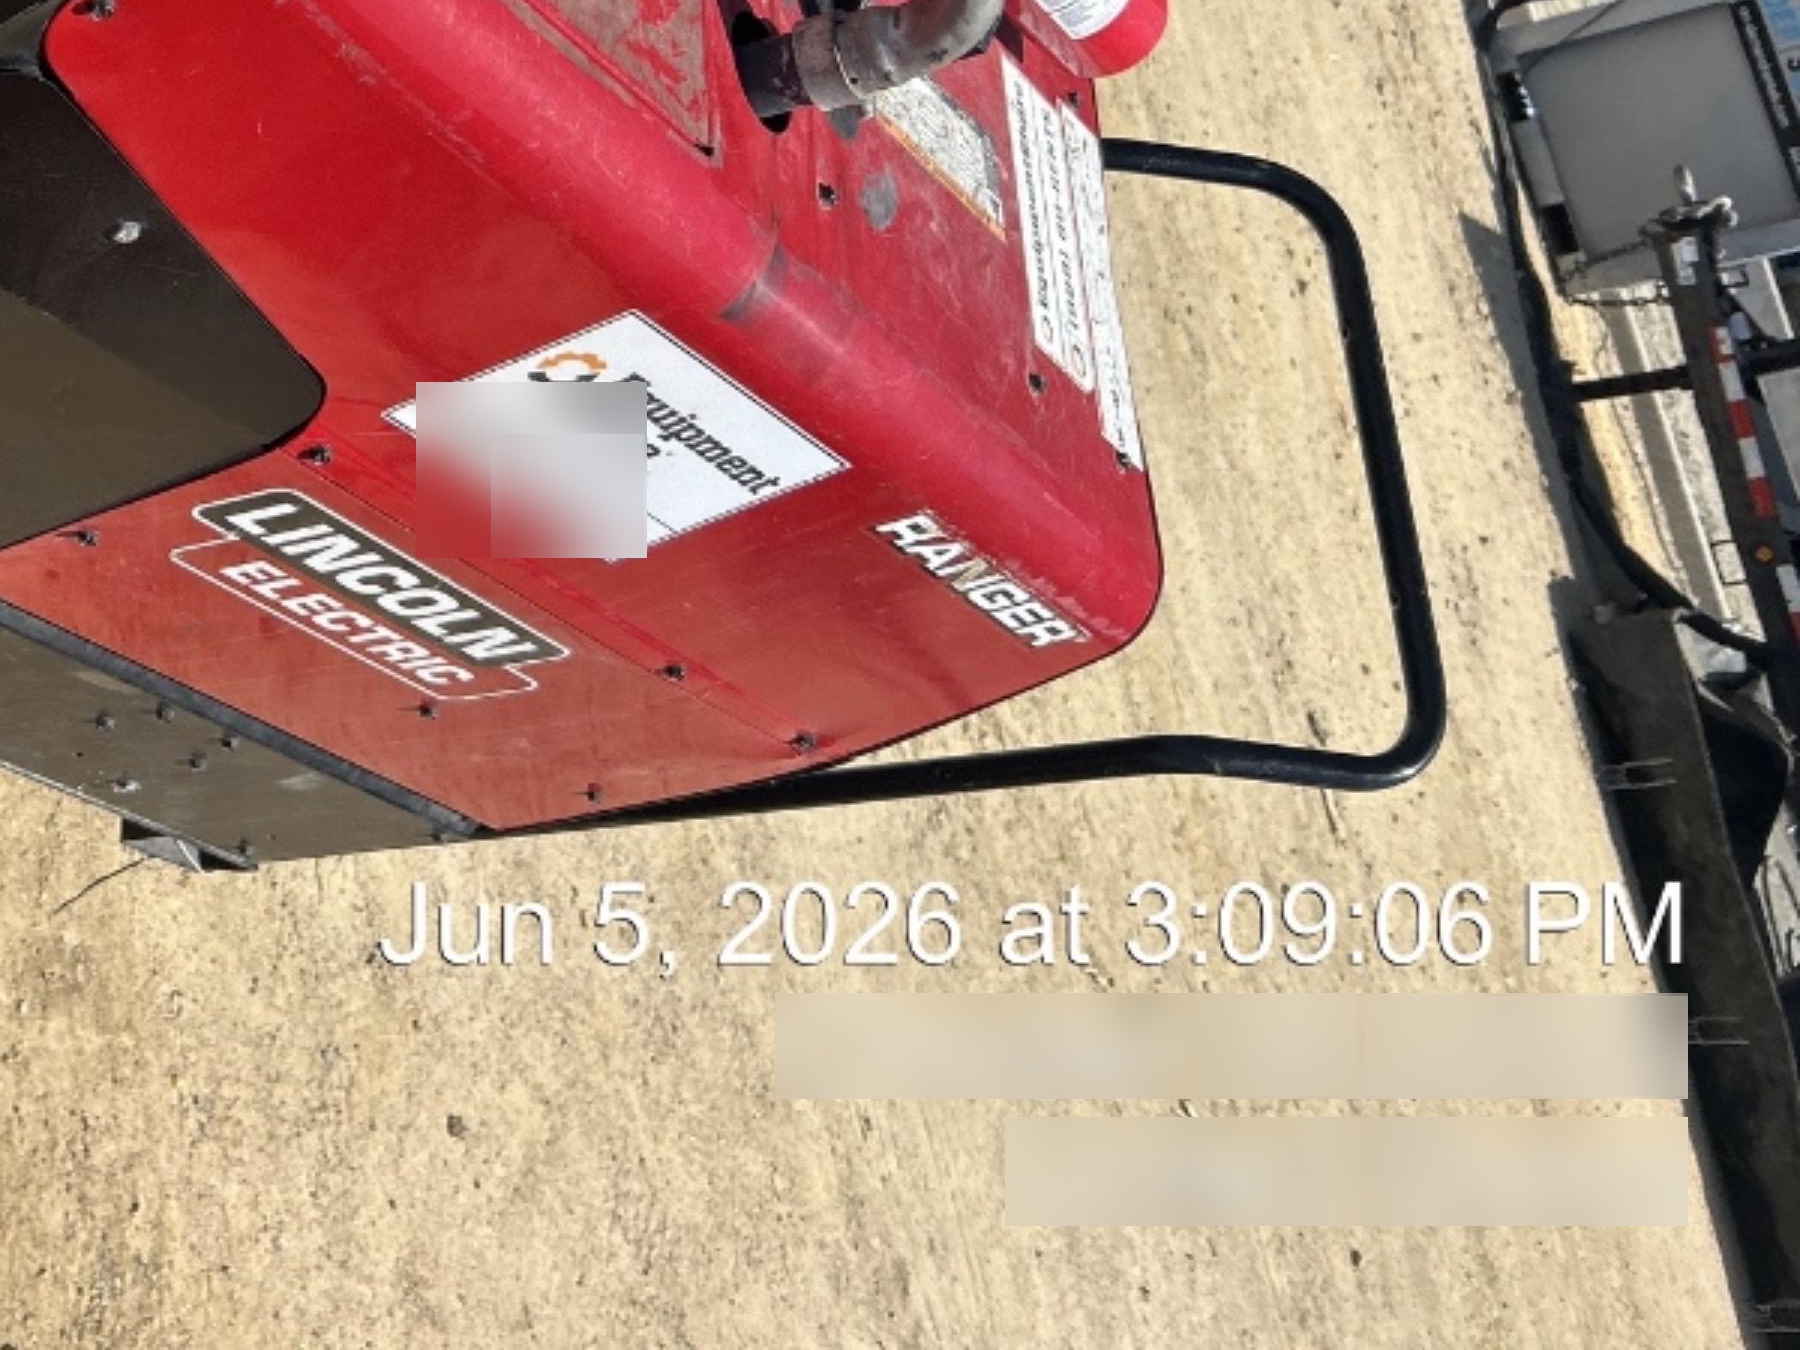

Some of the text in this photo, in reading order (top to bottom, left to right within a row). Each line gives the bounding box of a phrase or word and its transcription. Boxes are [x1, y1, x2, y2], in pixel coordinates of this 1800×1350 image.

[613, 372, 781, 495] uipment
[220, 560, 474, 685] ELECTRIC
[225, 503, 538, 661] LINCOLN
[875, 514, 1078, 647] RANGER
